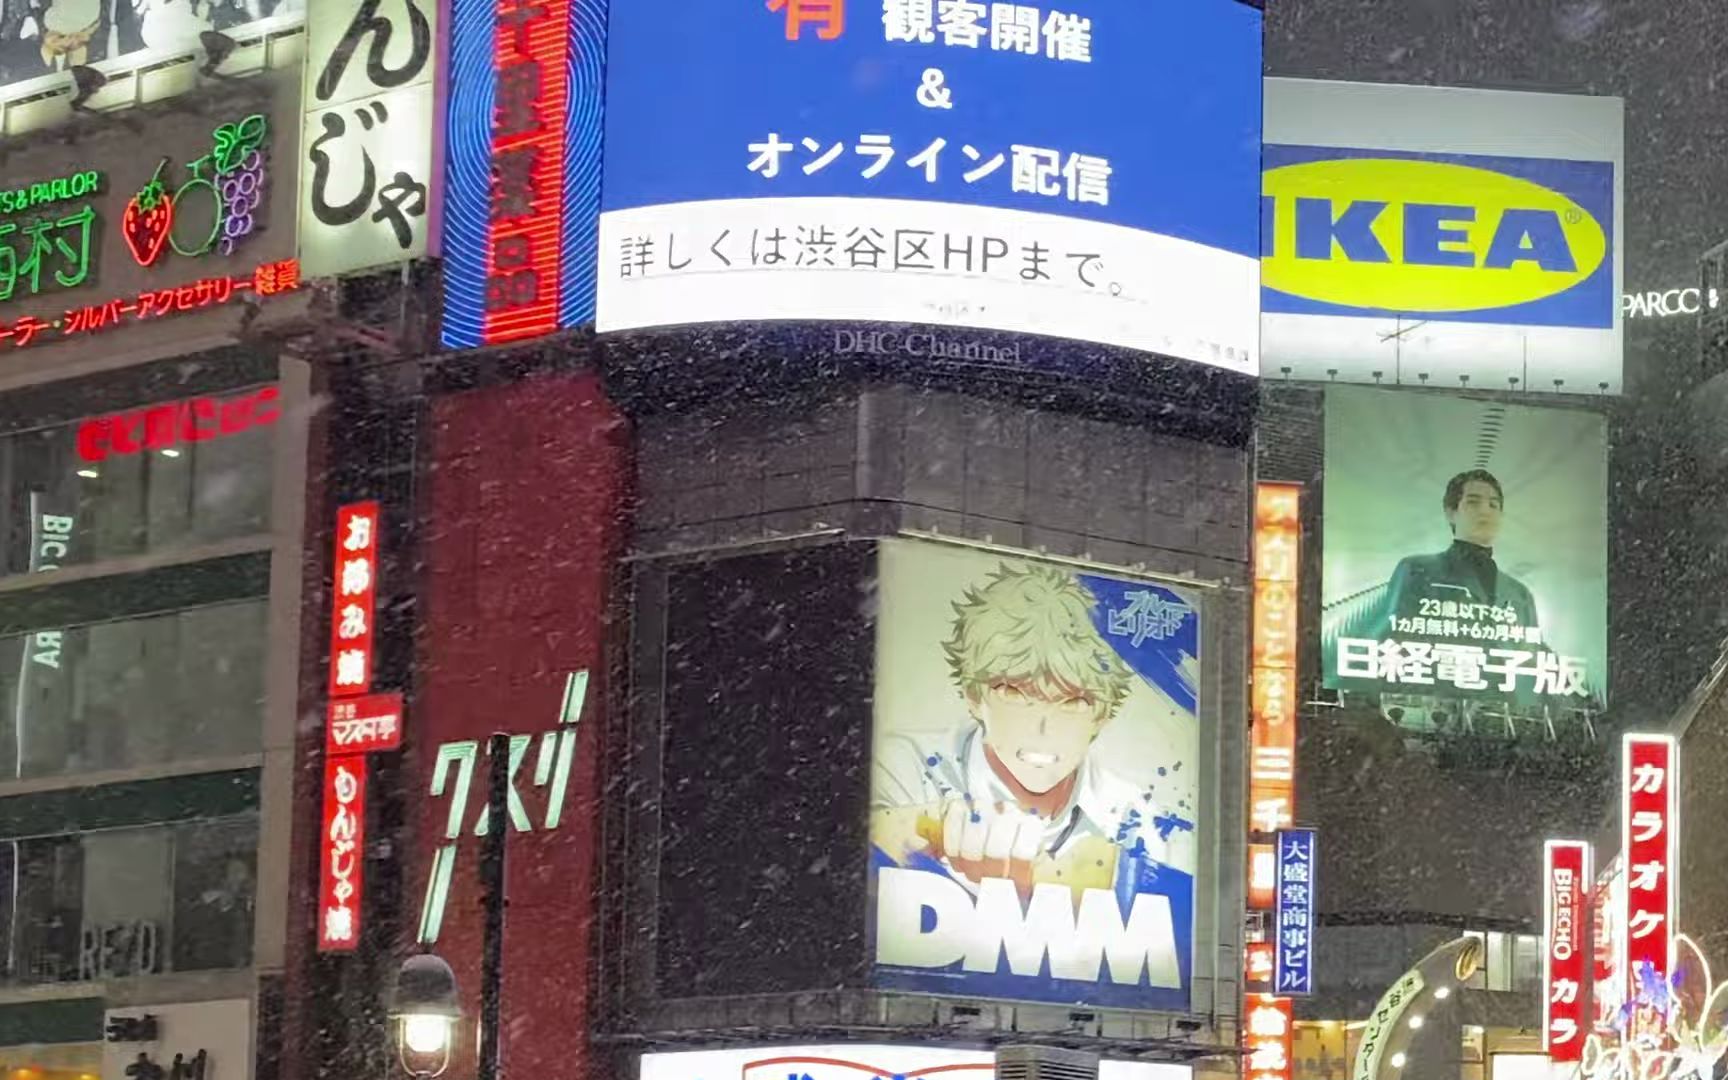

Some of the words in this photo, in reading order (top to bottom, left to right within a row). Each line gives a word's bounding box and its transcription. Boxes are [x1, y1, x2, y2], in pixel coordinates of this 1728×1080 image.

[881, 0, 1093, 63] 観客開催
[916, 68, 953, 109] &
[746, 133, 1113, 205] オンライン配信
[620, 224, 1124, 297] 詳しくは渋谷区HPまで。
[835, 330, 898, 354] DHC
[905, 334, 1020, 363] Channel
[1335, 636, 1590, 697] 日経電子版
[1283, 841, 1309, 989] 大盛堂商事ビル
[1553, 868, 1572, 906] BIG
[876, 866, 1181, 988] DMM
[1553, 909, 1572, 960] ECHO
[1551, 977, 1579, 1045] カラ
